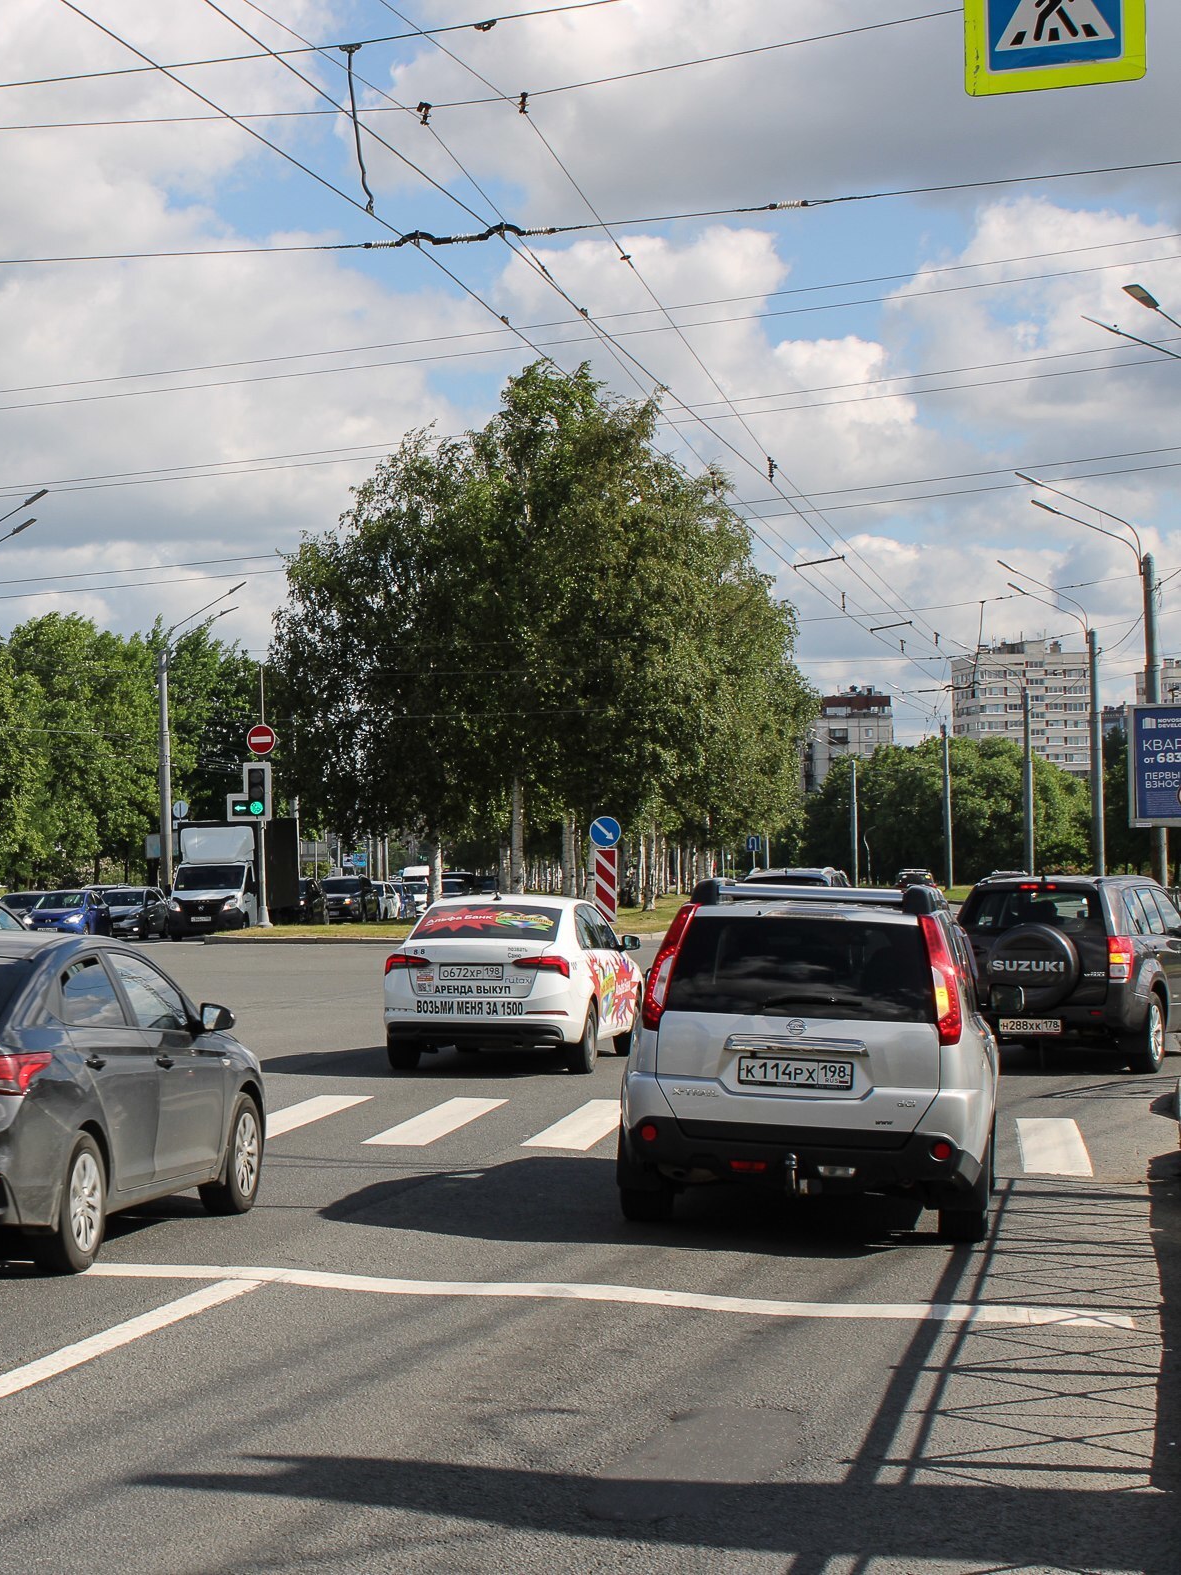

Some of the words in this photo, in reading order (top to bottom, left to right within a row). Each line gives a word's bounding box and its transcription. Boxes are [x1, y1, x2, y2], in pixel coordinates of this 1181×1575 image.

[1145, 780, 1179, 788] ВЗНОС
[484, 967, 500, 975] 198
[992, 960, 1065, 972] SUZUKI
[435, 985, 473, 995] АРЕНДА
[476, 985, 511, 994] ВЫКУП
[416, 1000, 454, 1014] ВОЗЬМИ
[457, 1001, 483, 1015] МЕНЯ
[486, 1001, 499, 1015] ЗА
[501, 1001, 523, 1016] 1500
[1043, 1020, 1059, 1029] 178
[820, 1064, 847, 1079] 198
